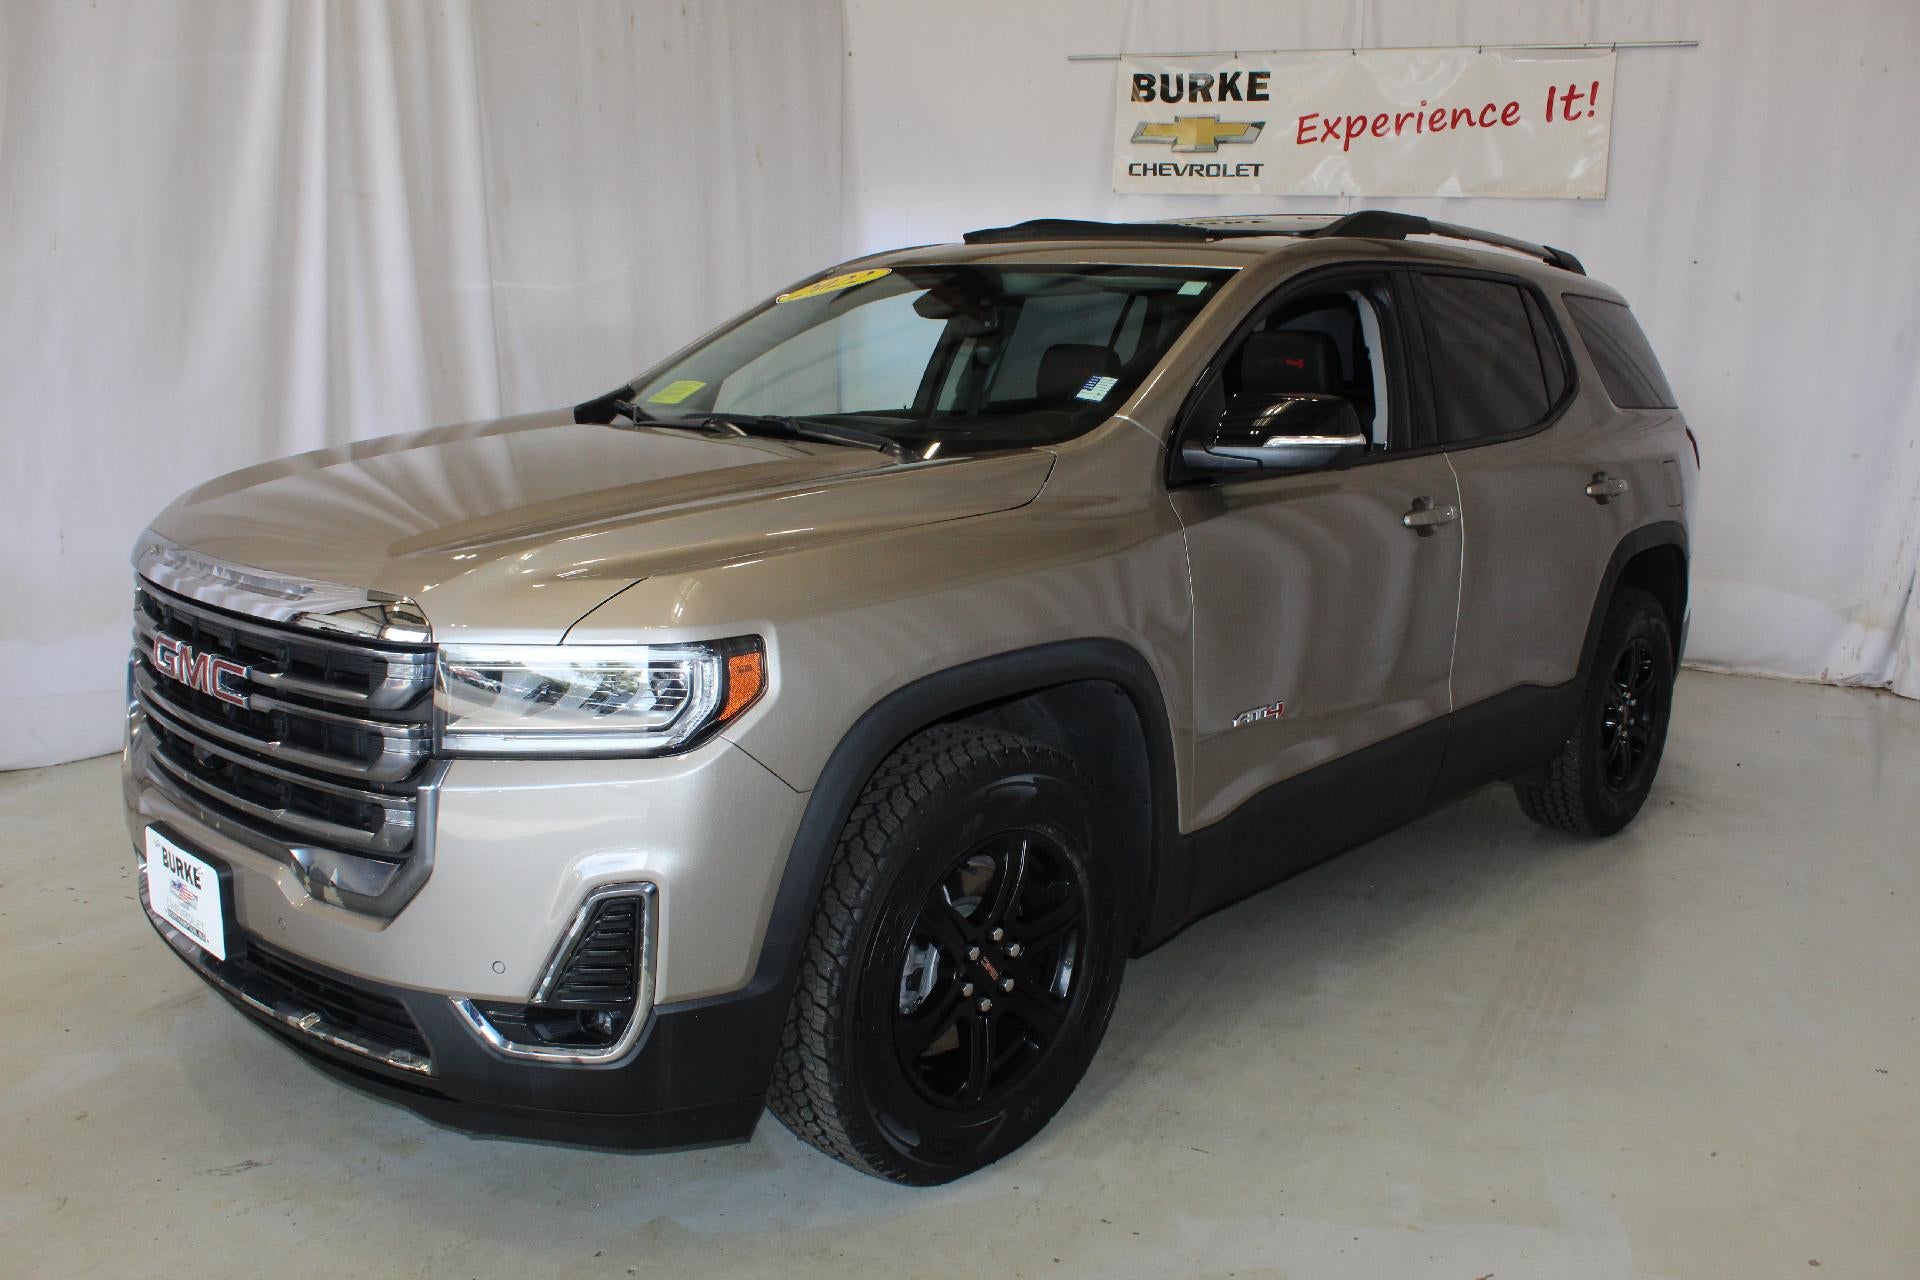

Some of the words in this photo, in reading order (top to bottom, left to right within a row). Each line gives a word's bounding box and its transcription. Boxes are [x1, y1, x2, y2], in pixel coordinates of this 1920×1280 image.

[1130, 71, 1271, 104] BURKE
[1296, 99, 1521, 152] Experience
[1545, 80, 1600, 123] It!
[1128, 162, 1265, 178] CHEVROLET
[154, 631, 251, 710] GMC
[1232, 701, 1285, 727] AT4
[161, 846, 202, 890] BURKE
